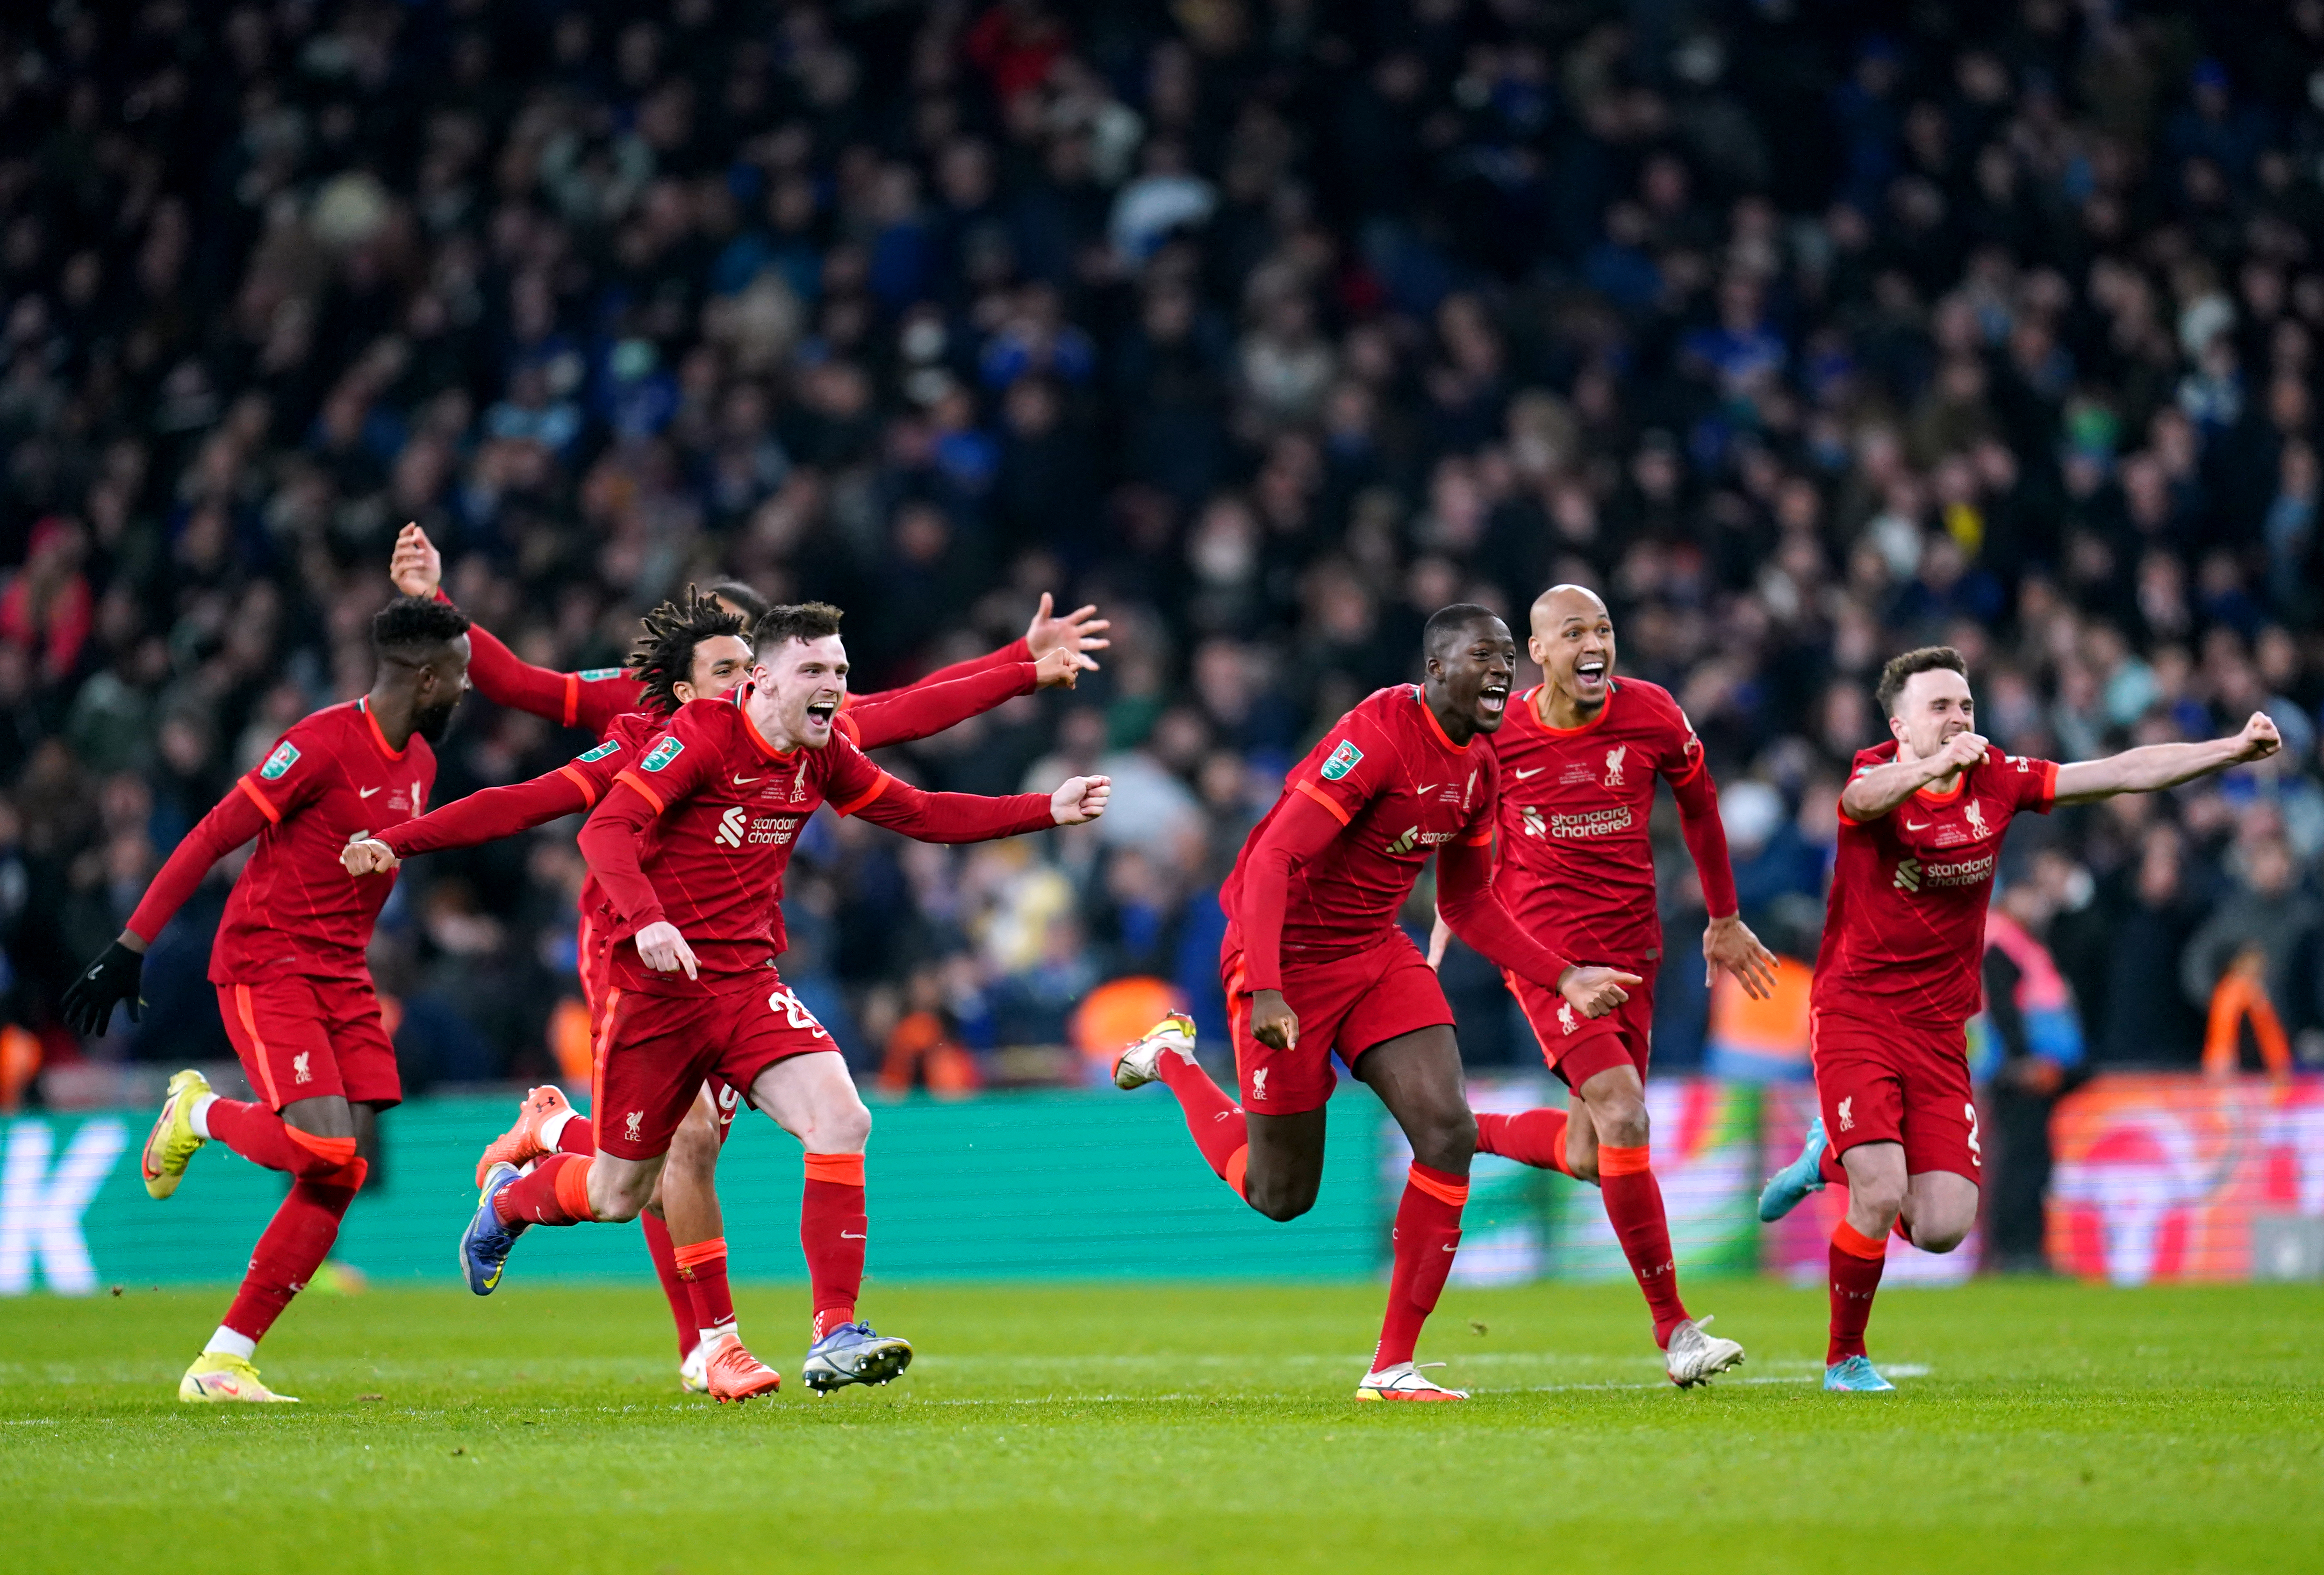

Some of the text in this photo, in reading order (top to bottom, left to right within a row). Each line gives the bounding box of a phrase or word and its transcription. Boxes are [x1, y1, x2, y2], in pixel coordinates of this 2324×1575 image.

[1551, 805, 1628, 827] standard
[1551, 813, 1632, 838] chartered
[1928, 853, 1993, 877] standard
